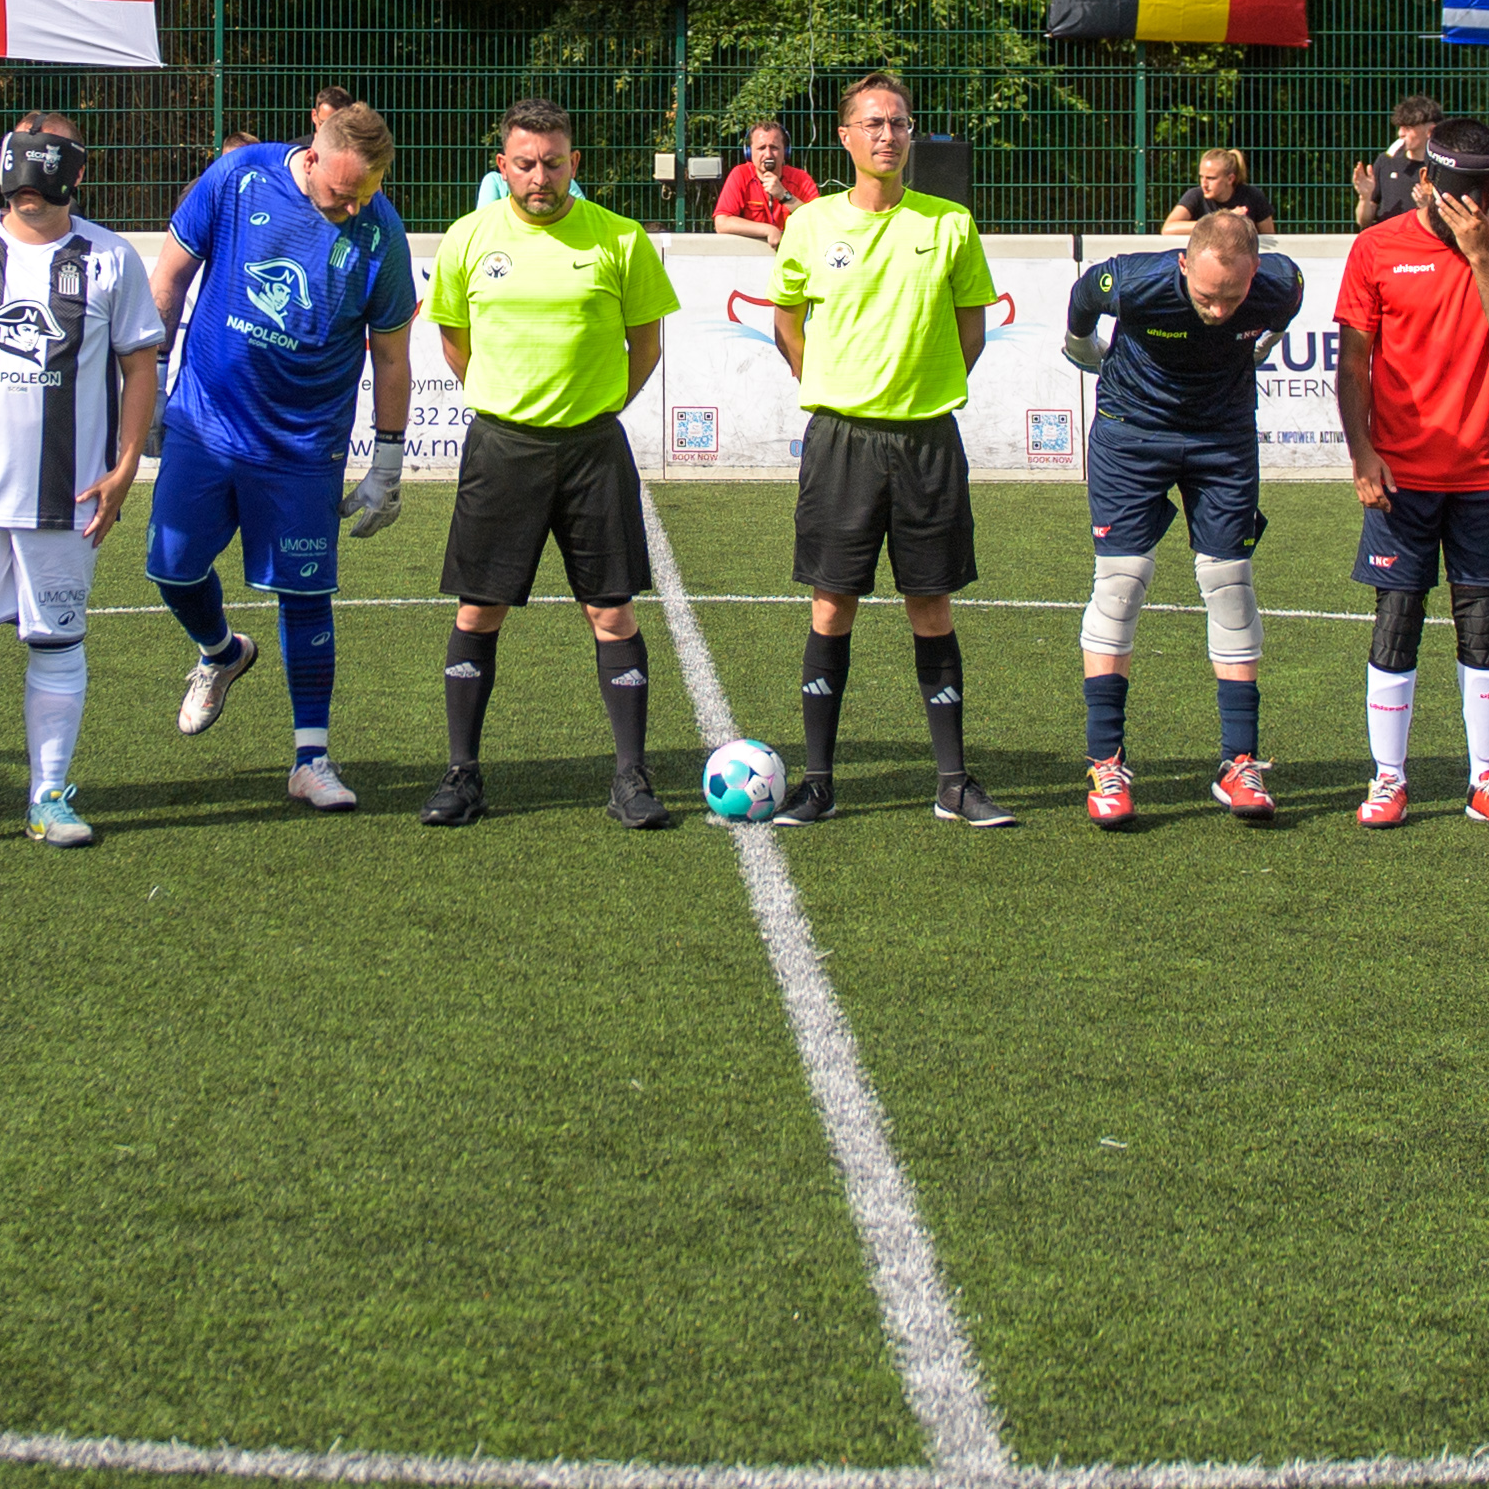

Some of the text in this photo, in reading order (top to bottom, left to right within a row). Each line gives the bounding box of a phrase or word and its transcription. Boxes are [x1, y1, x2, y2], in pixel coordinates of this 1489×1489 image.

[1393, 263, 1435, 275] uhlsport
[226, 315, 299, 352] NAPOLEON
[1147, 328, 1188, 340] uhlsport
[672, 453, 719, 461] BOOK NOW
[1028, 456, 1073, 464] BOOK NOW
[280, 537, 327, 552] UMONS
[1369, 554, 1391, 567] RNC
[38, 590, 86, 604] UMONS
